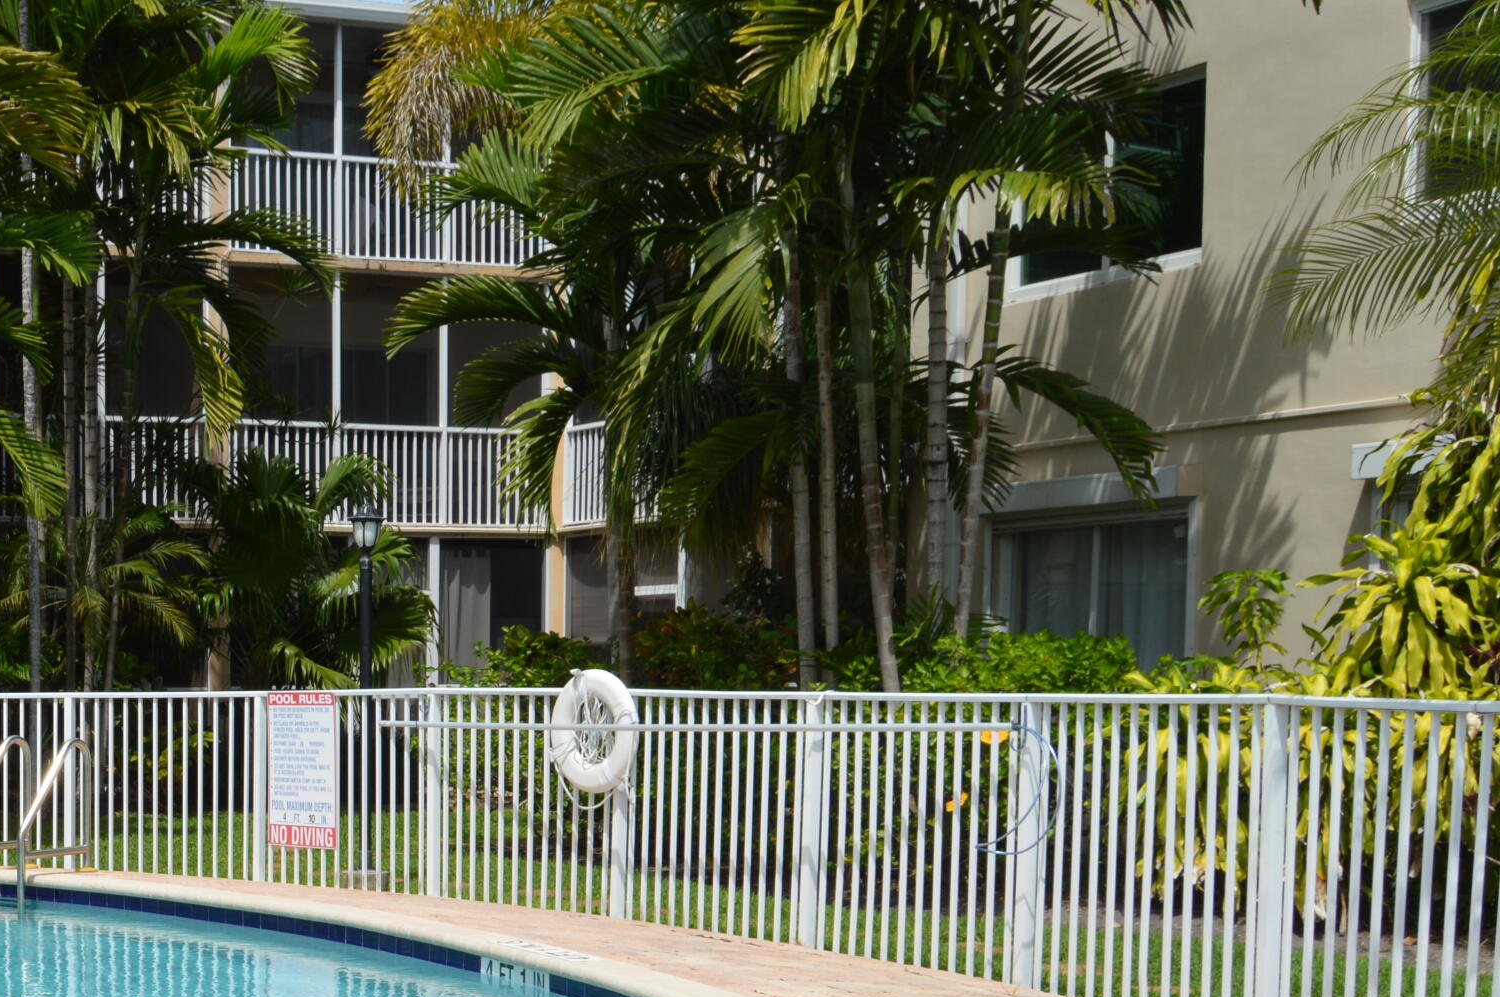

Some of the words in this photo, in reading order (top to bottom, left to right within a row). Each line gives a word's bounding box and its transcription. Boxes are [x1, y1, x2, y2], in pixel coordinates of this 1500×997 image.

[269, 693, 297, 705] POOL
[298, 693, 333, 705] RULES
[271, 799, 286, 811] POOL
[286, 800, 313, 812] MAXIMUM
[313, 801, 332, 813] DEPTH
[282, 811, 287, 820] 4
[308, 813, 316, 824] 10
[270, 825, 288, 845] NO
[291, 826, 334, 848] DIVING
[499, 962, 514, 980] FT
[520, 967, 526, 984] 1
[533, 971, 545, 988] IN
